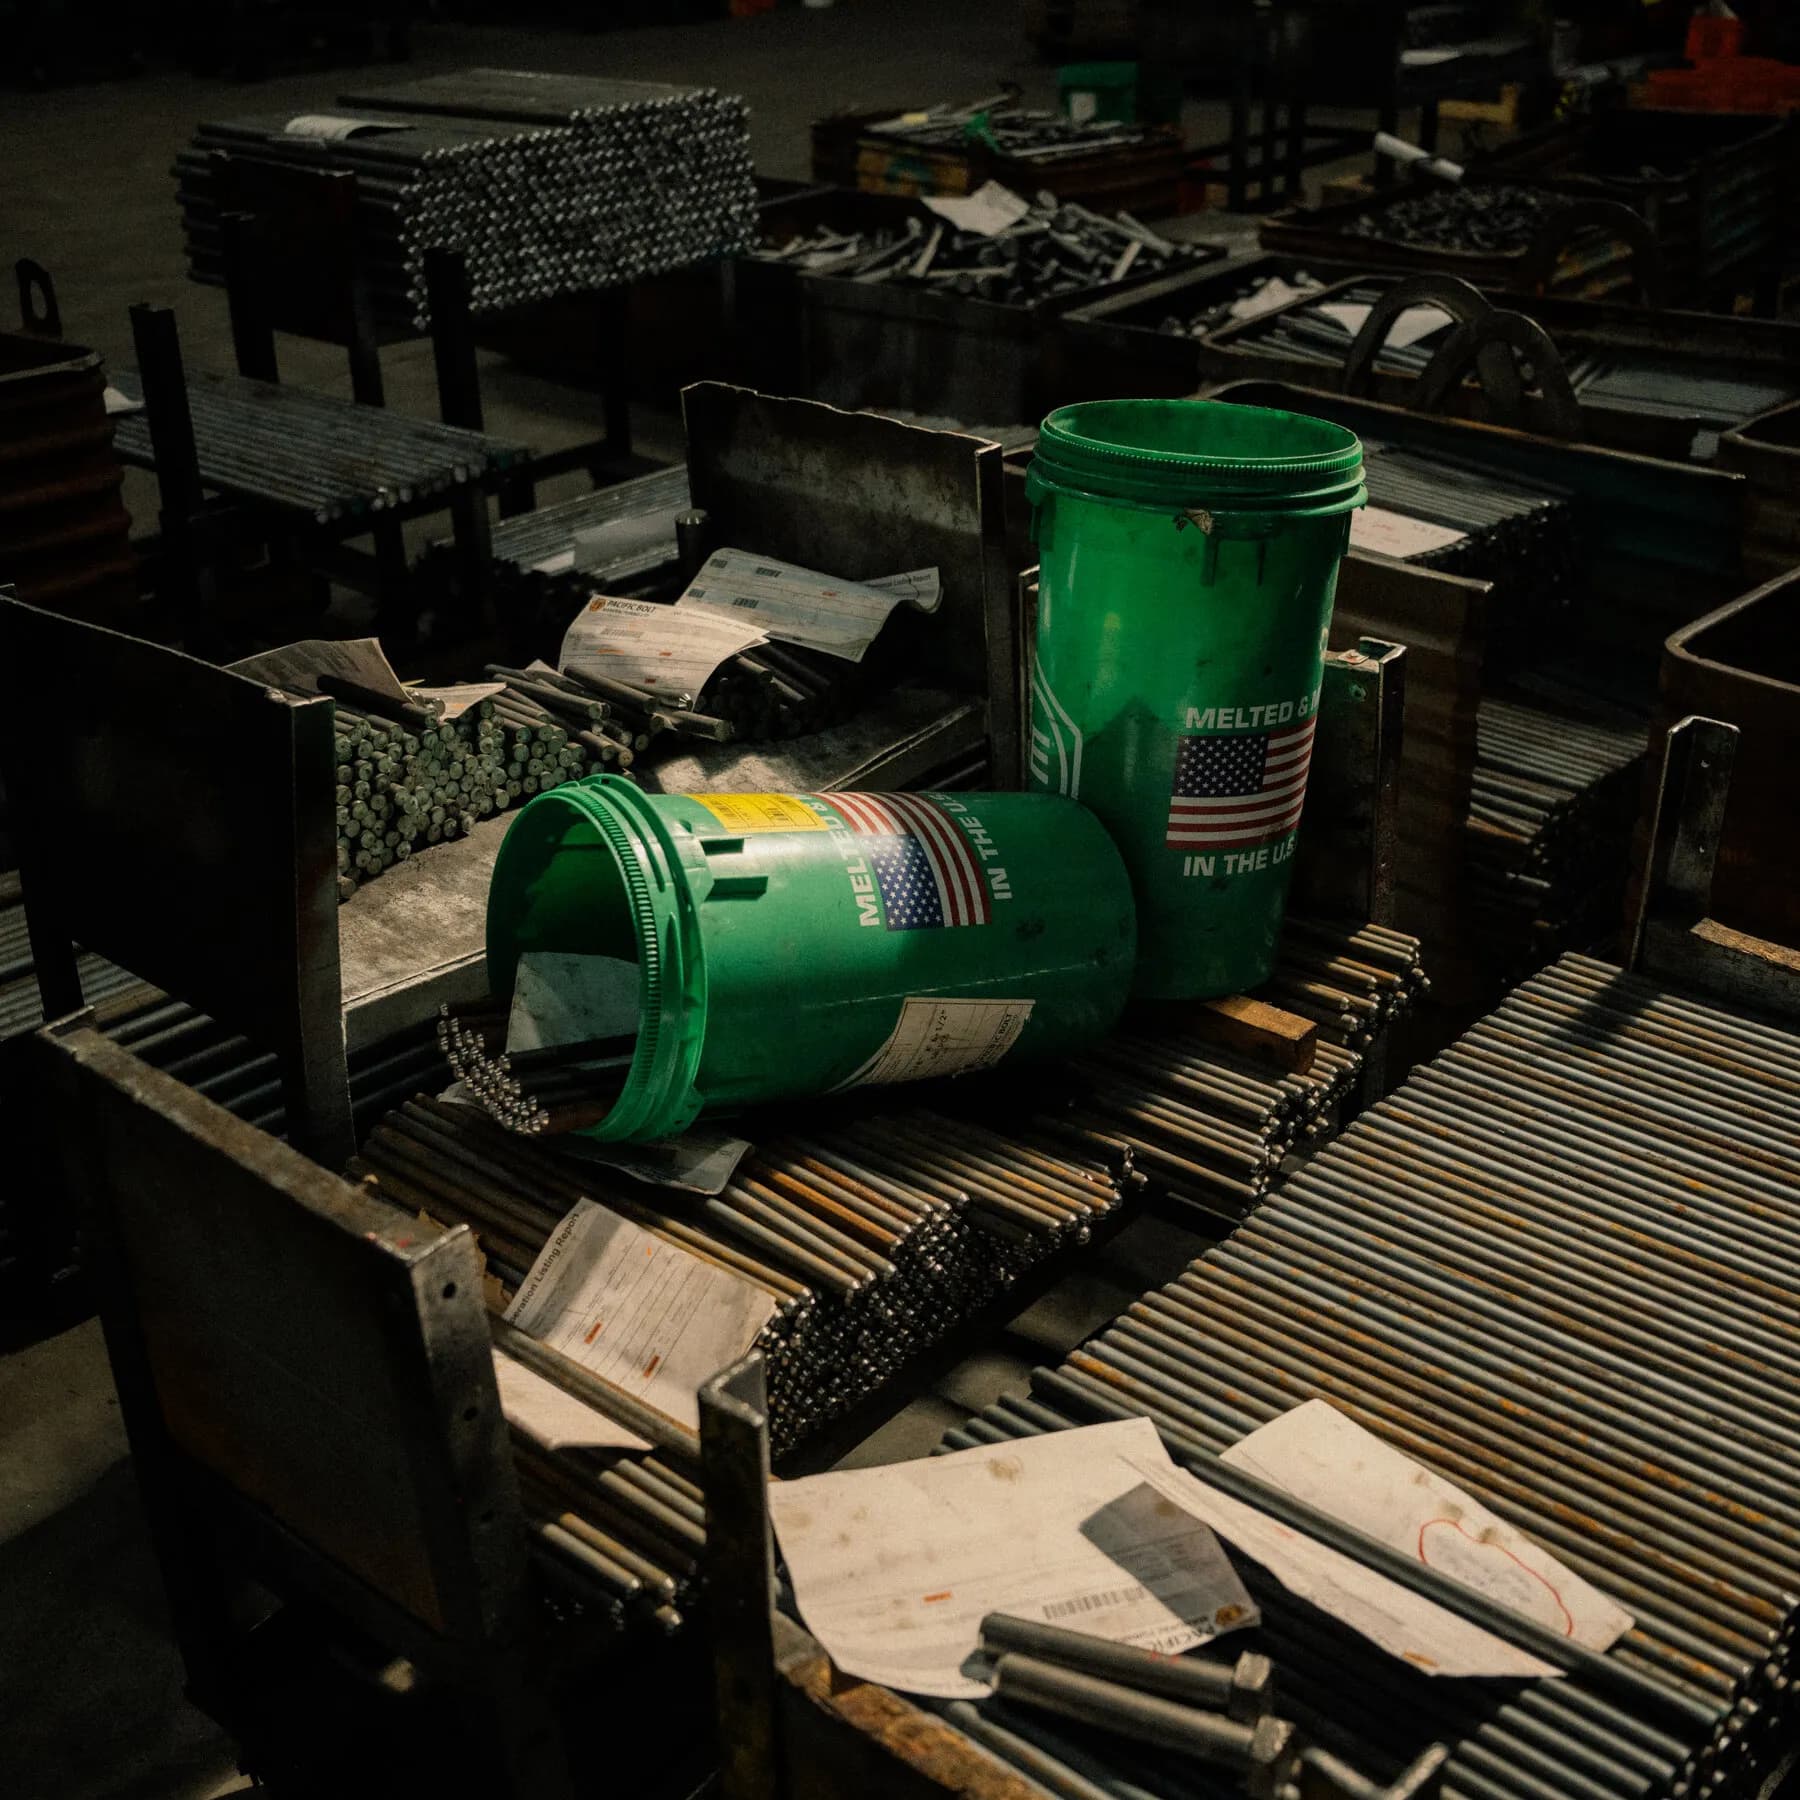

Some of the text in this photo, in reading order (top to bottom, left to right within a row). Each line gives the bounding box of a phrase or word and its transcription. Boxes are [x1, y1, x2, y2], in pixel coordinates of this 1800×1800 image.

[607, 600, 638, 612] PACIFIC
[636, 604, 656, 614] BOLT
[1184, 700, 1294, 729] MELTED
[1297, 695, 1308, 717] &
[959, 816, 999, 860] THE
[828, 815, 880, 926] MELTED
[1183, 855, 1216, 877] IN
[1222, 848, 1269, 876] THE
[987, 867, 1013, 900] IN
[534, 1247, 561, 1282] Listing
[556, 1213, 580, 1247] Report
